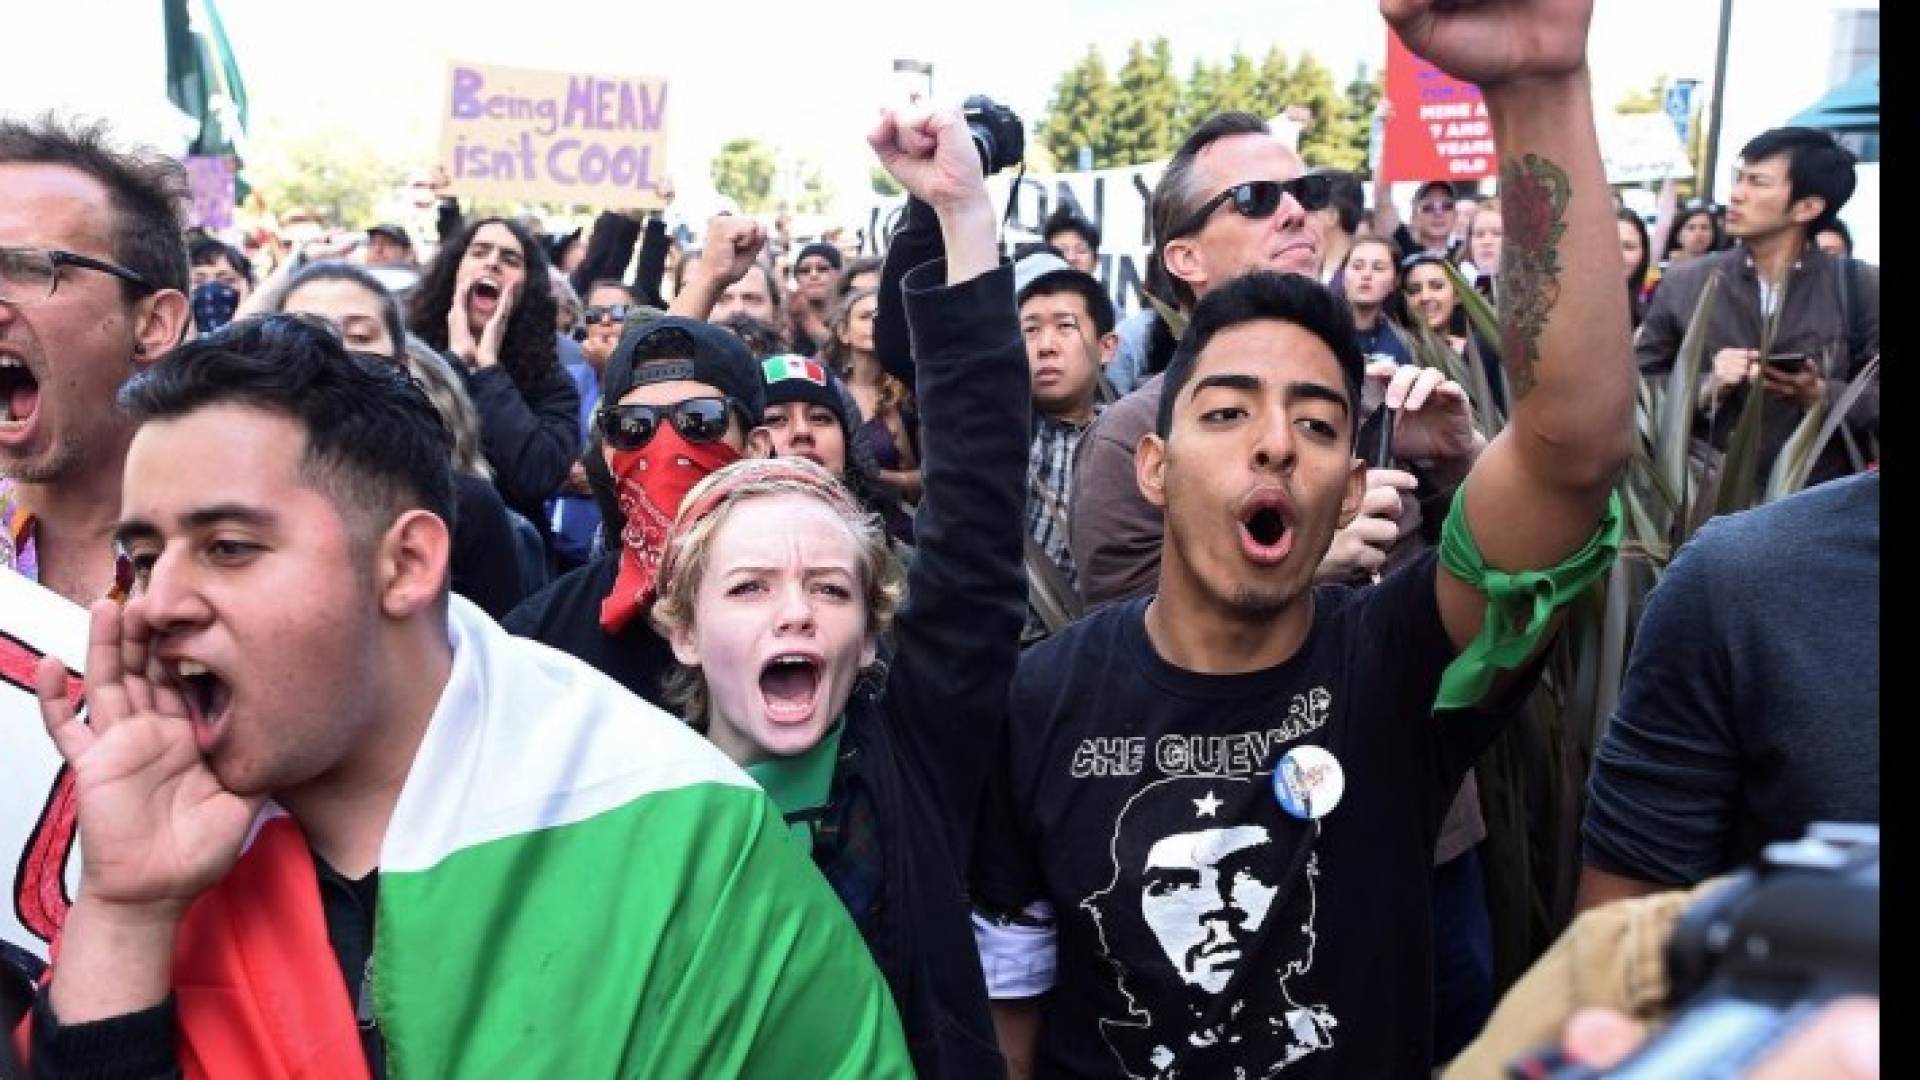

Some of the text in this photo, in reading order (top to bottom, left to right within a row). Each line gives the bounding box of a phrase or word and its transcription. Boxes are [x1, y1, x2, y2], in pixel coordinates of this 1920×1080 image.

[454, 68, 667, 134] Being MEAN
[545, 138, 658, 190] COOL
[1071, 736, 1146, 778] CHE
